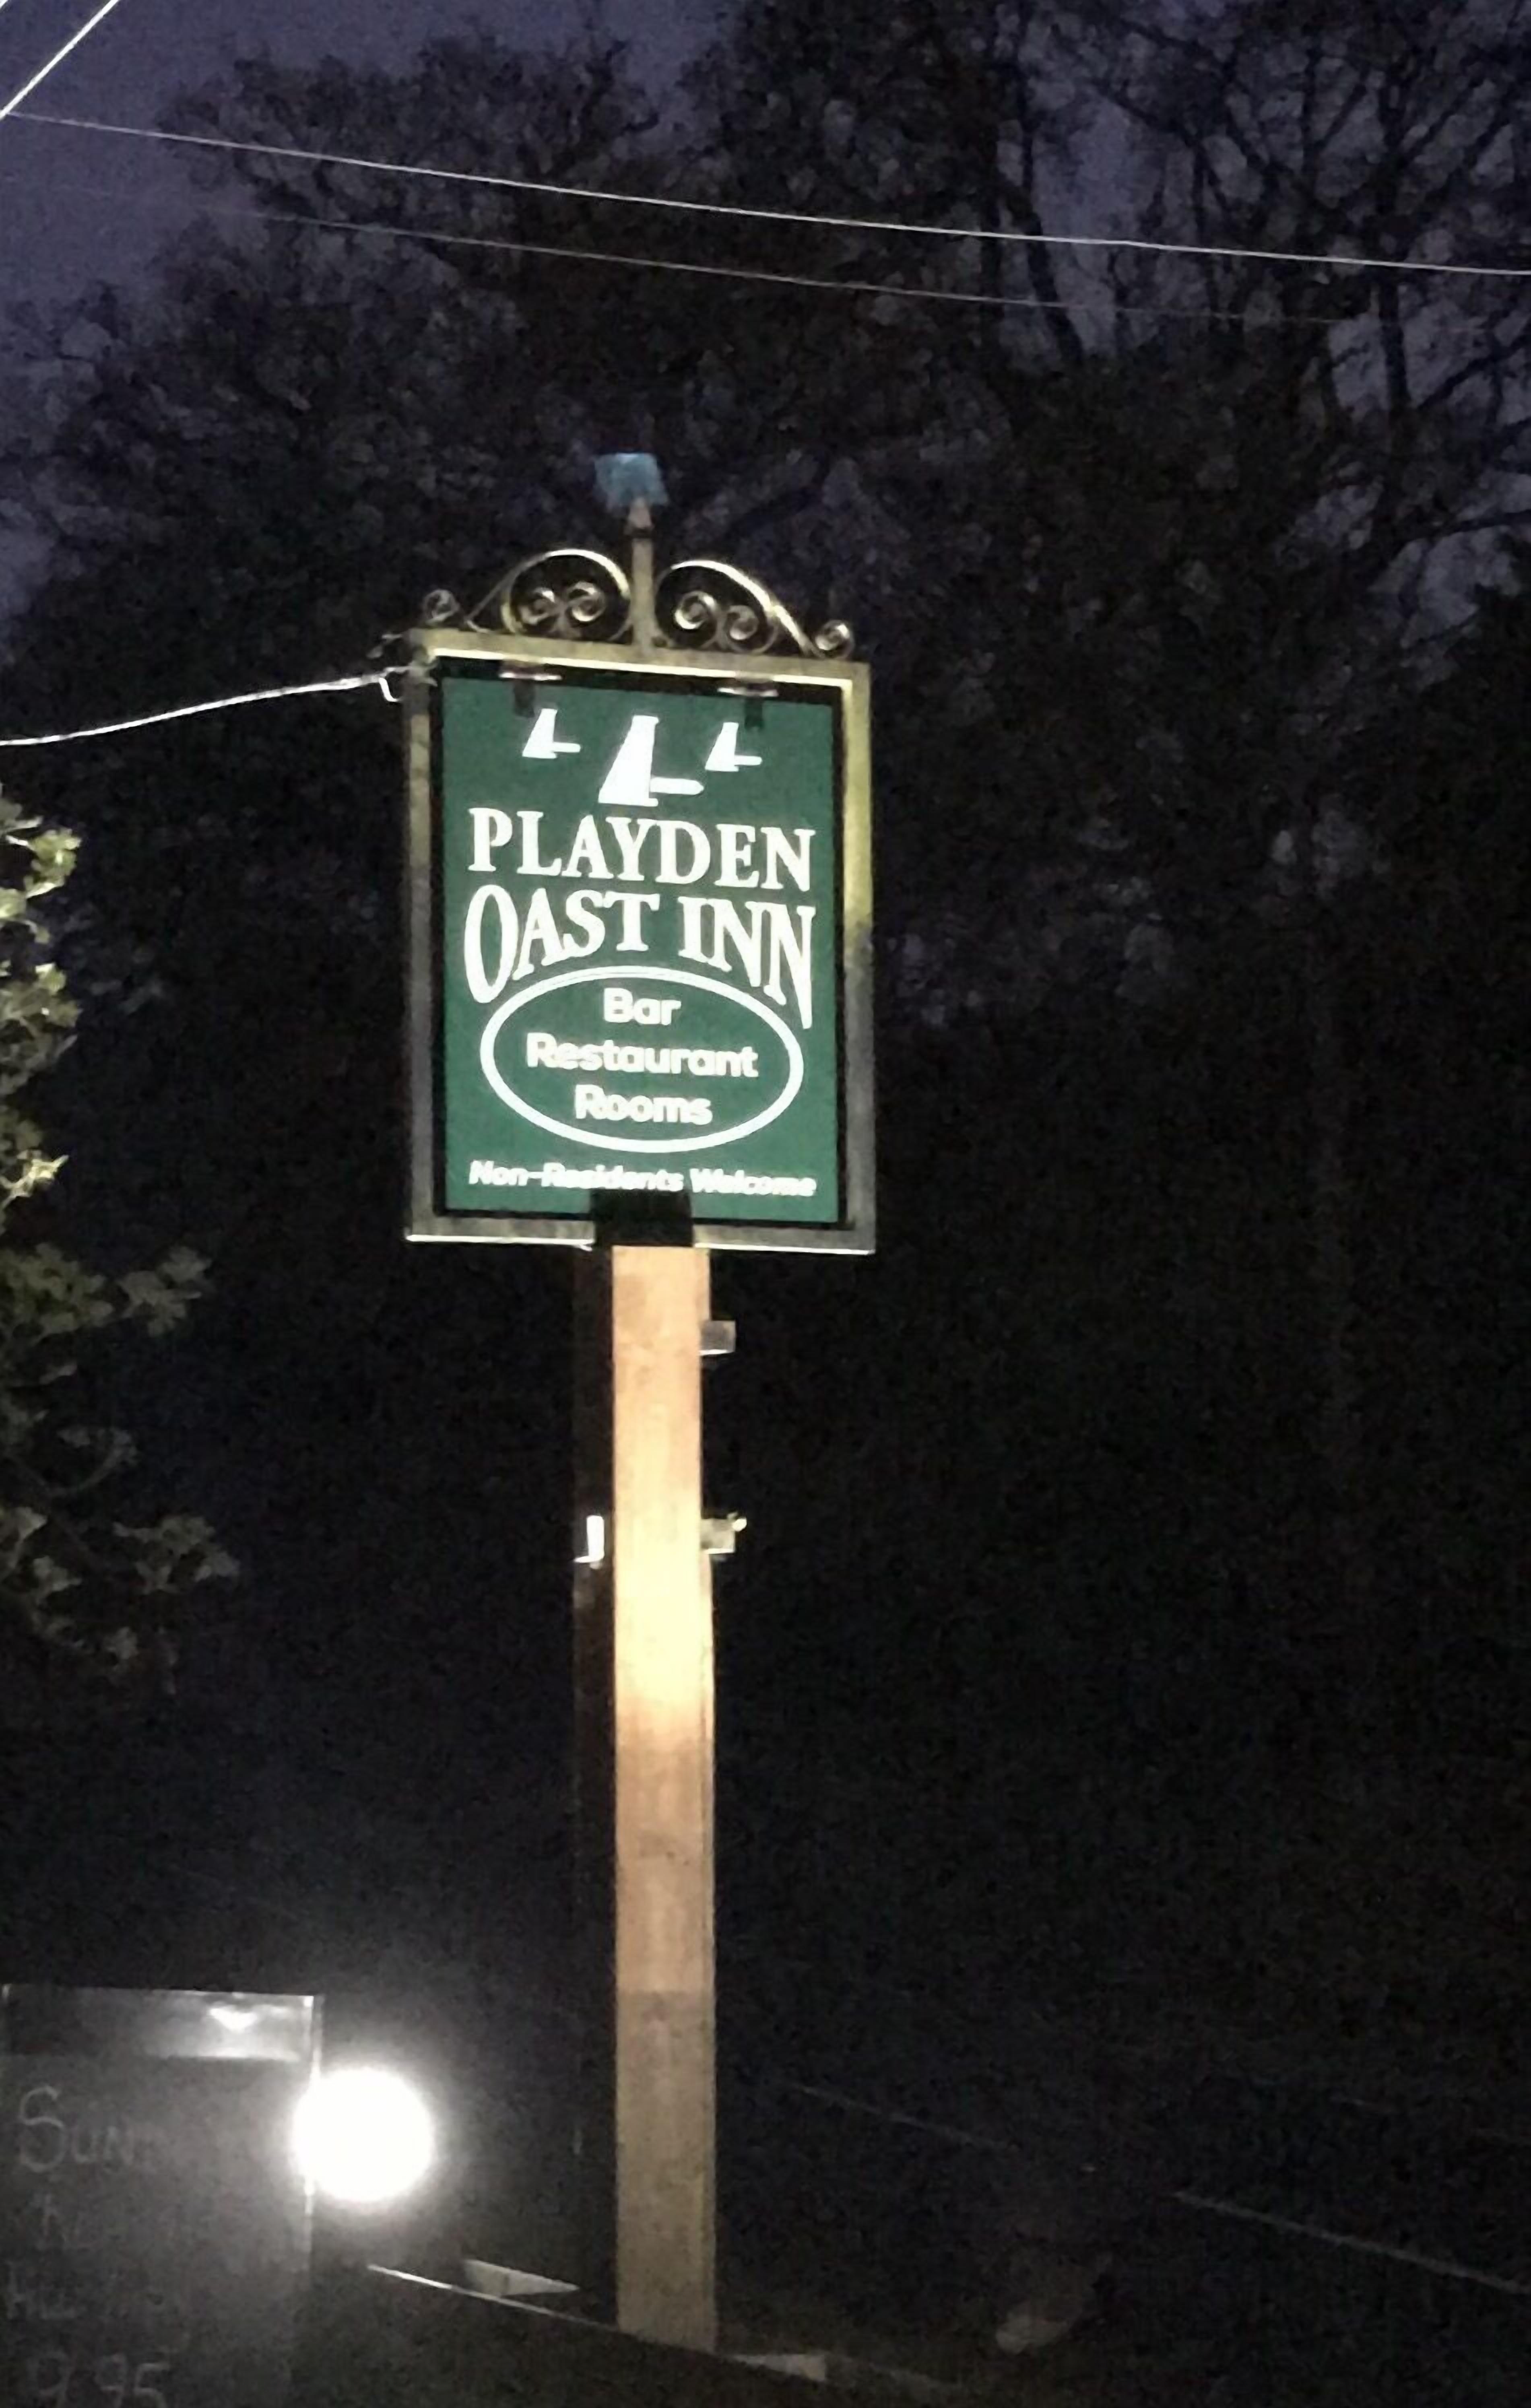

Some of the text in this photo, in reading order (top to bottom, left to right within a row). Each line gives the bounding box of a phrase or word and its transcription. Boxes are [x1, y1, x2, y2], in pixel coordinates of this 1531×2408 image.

[468, 807, 816, 892] PLAYDEN
[463, 884, 816, 1030] OAST INN
[603, 987, 682, 1026] Bar
[526, 1032, 759, 1078] Restaurant
[574, 1083, 713, 1126] Rooms
[468, 1160, 817, 1197] Non-Residents Welcome
